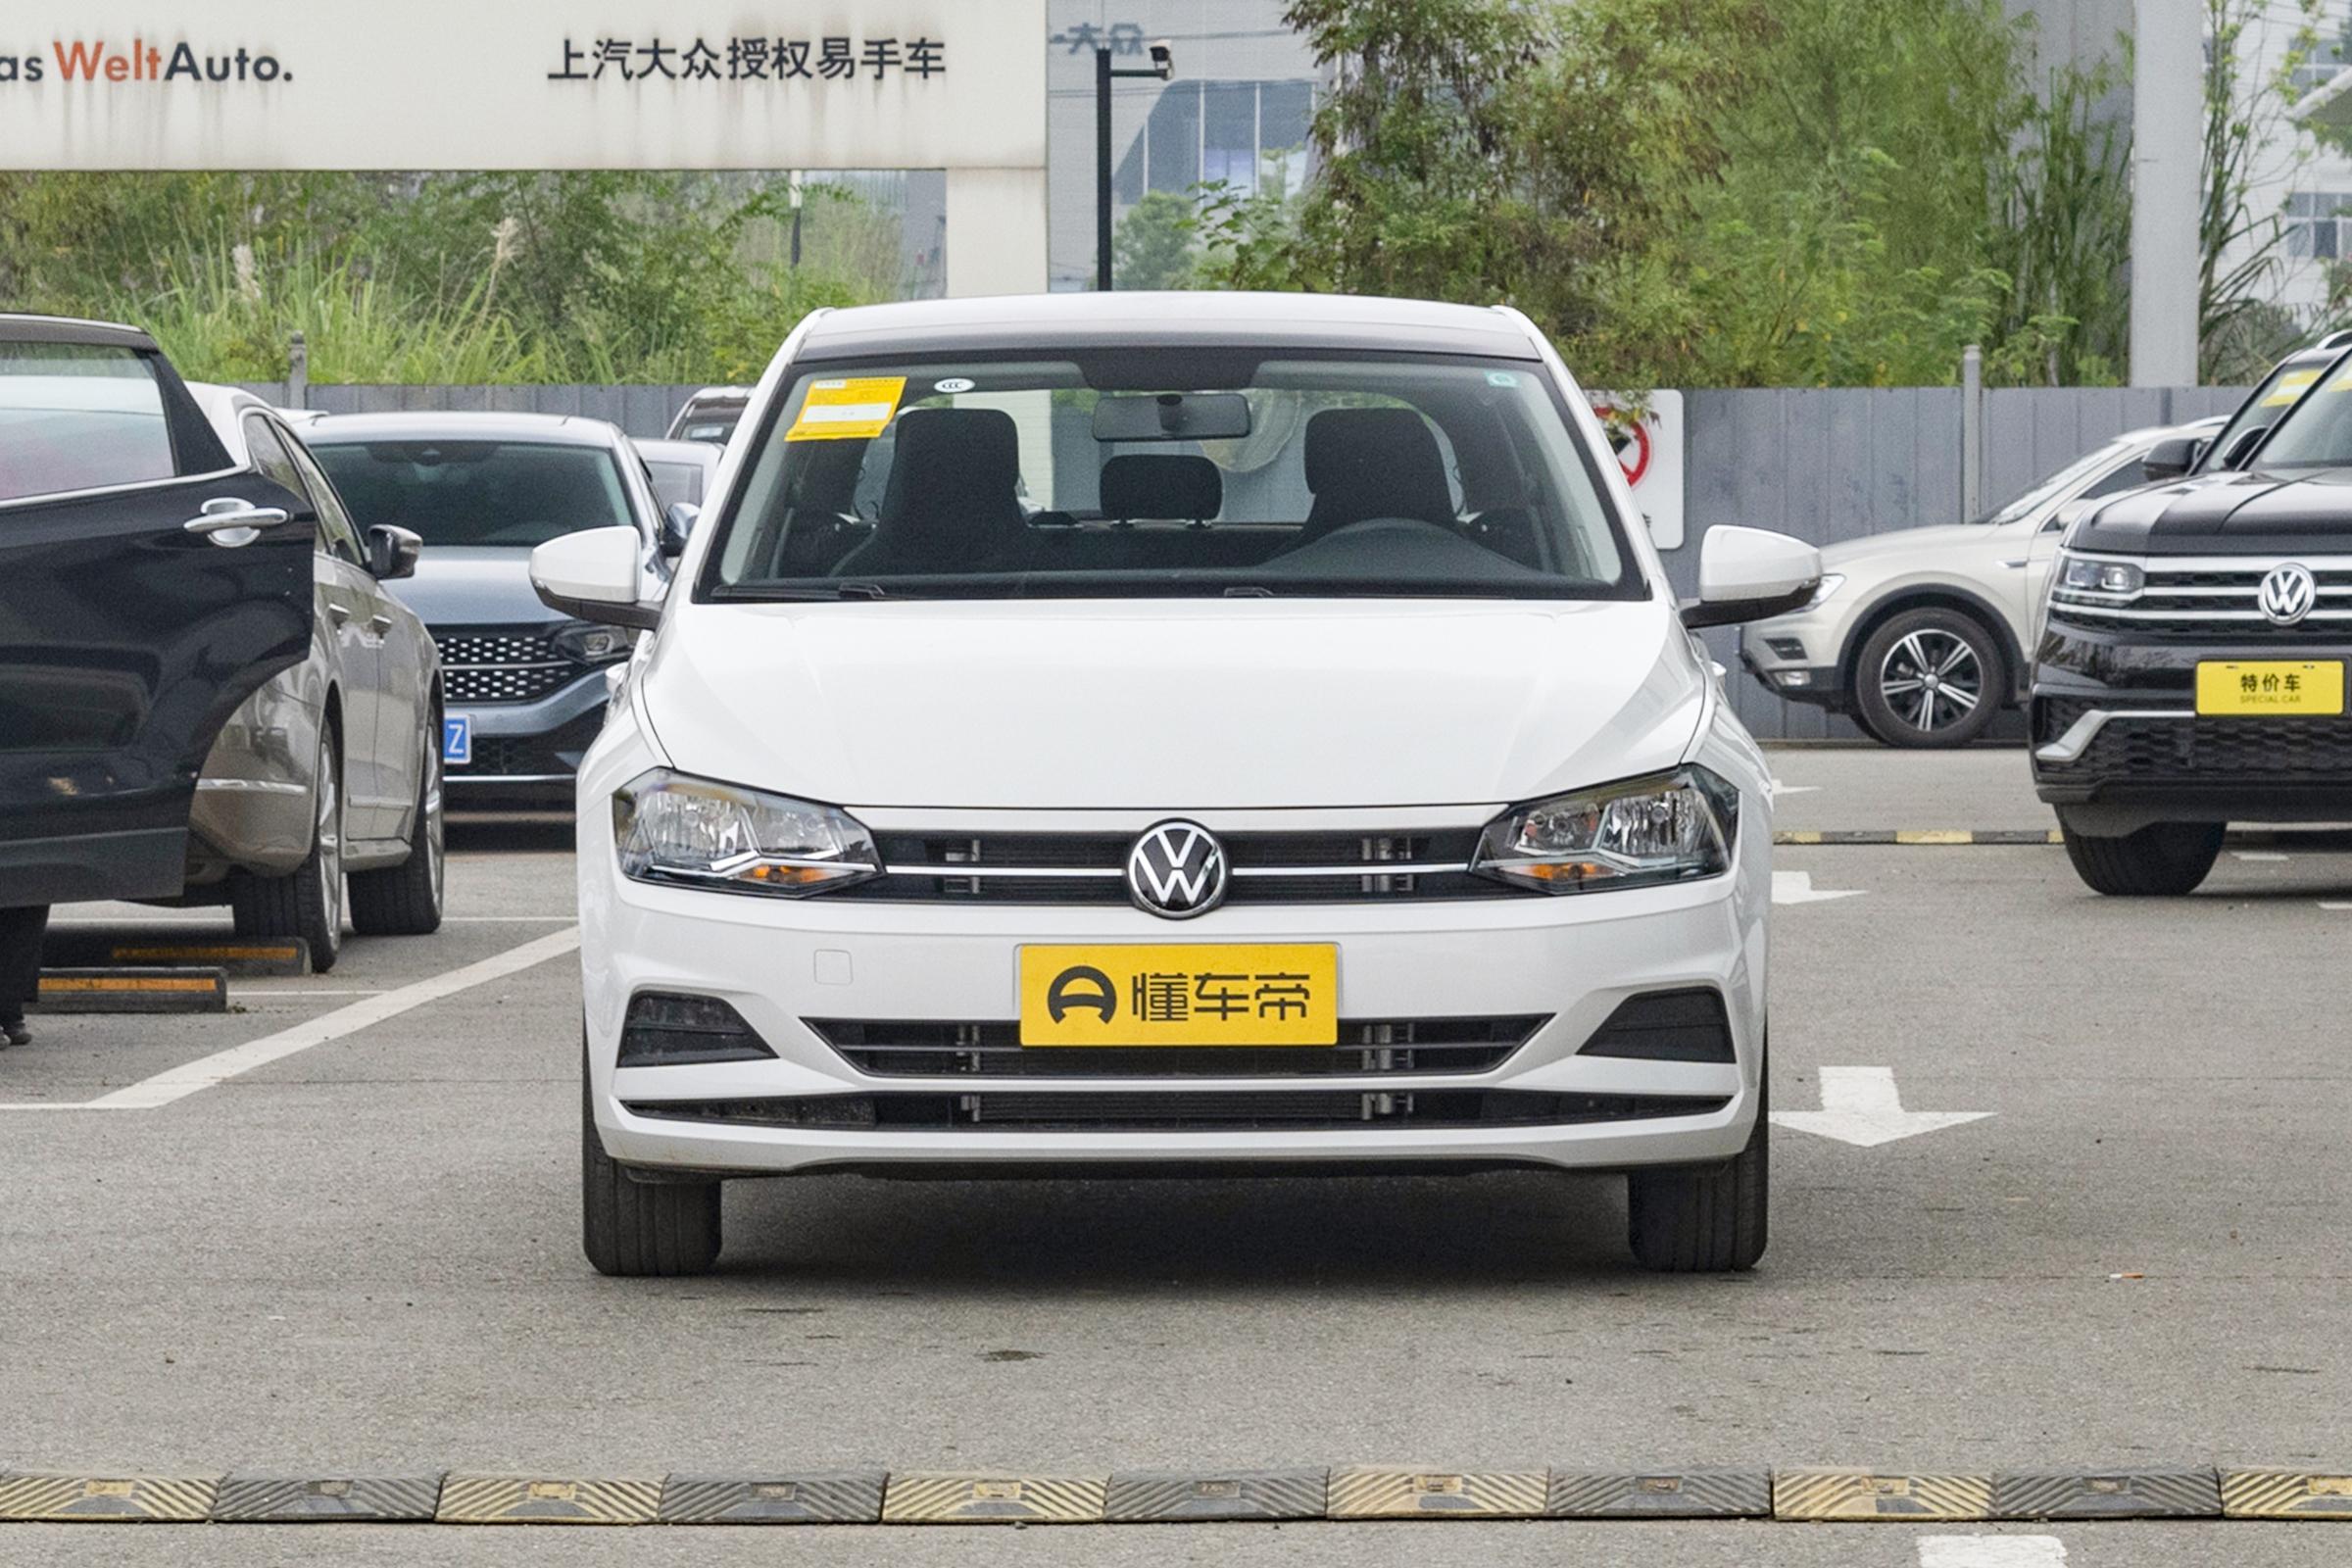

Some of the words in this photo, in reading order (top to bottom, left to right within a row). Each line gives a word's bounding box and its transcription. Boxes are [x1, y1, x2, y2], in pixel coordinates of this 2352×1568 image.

[0, 55, 44, 82] as
[53, 37, 293, 82] WeltAuto.
[547, 36, 947, 81] 上汽大众授权易手车
[2263, 567, 2311, 617] VW
[2240, 673, 2301, 693] 特价车
[2240, 695, 2278, 704] SPECIAL
[2281, 695, 2301, 704] CAR
[448, 723, 465, 754] Z
[1130, 823, 1224, 912] VW
[1132, 972, 1311, 1021] 懂车帝
